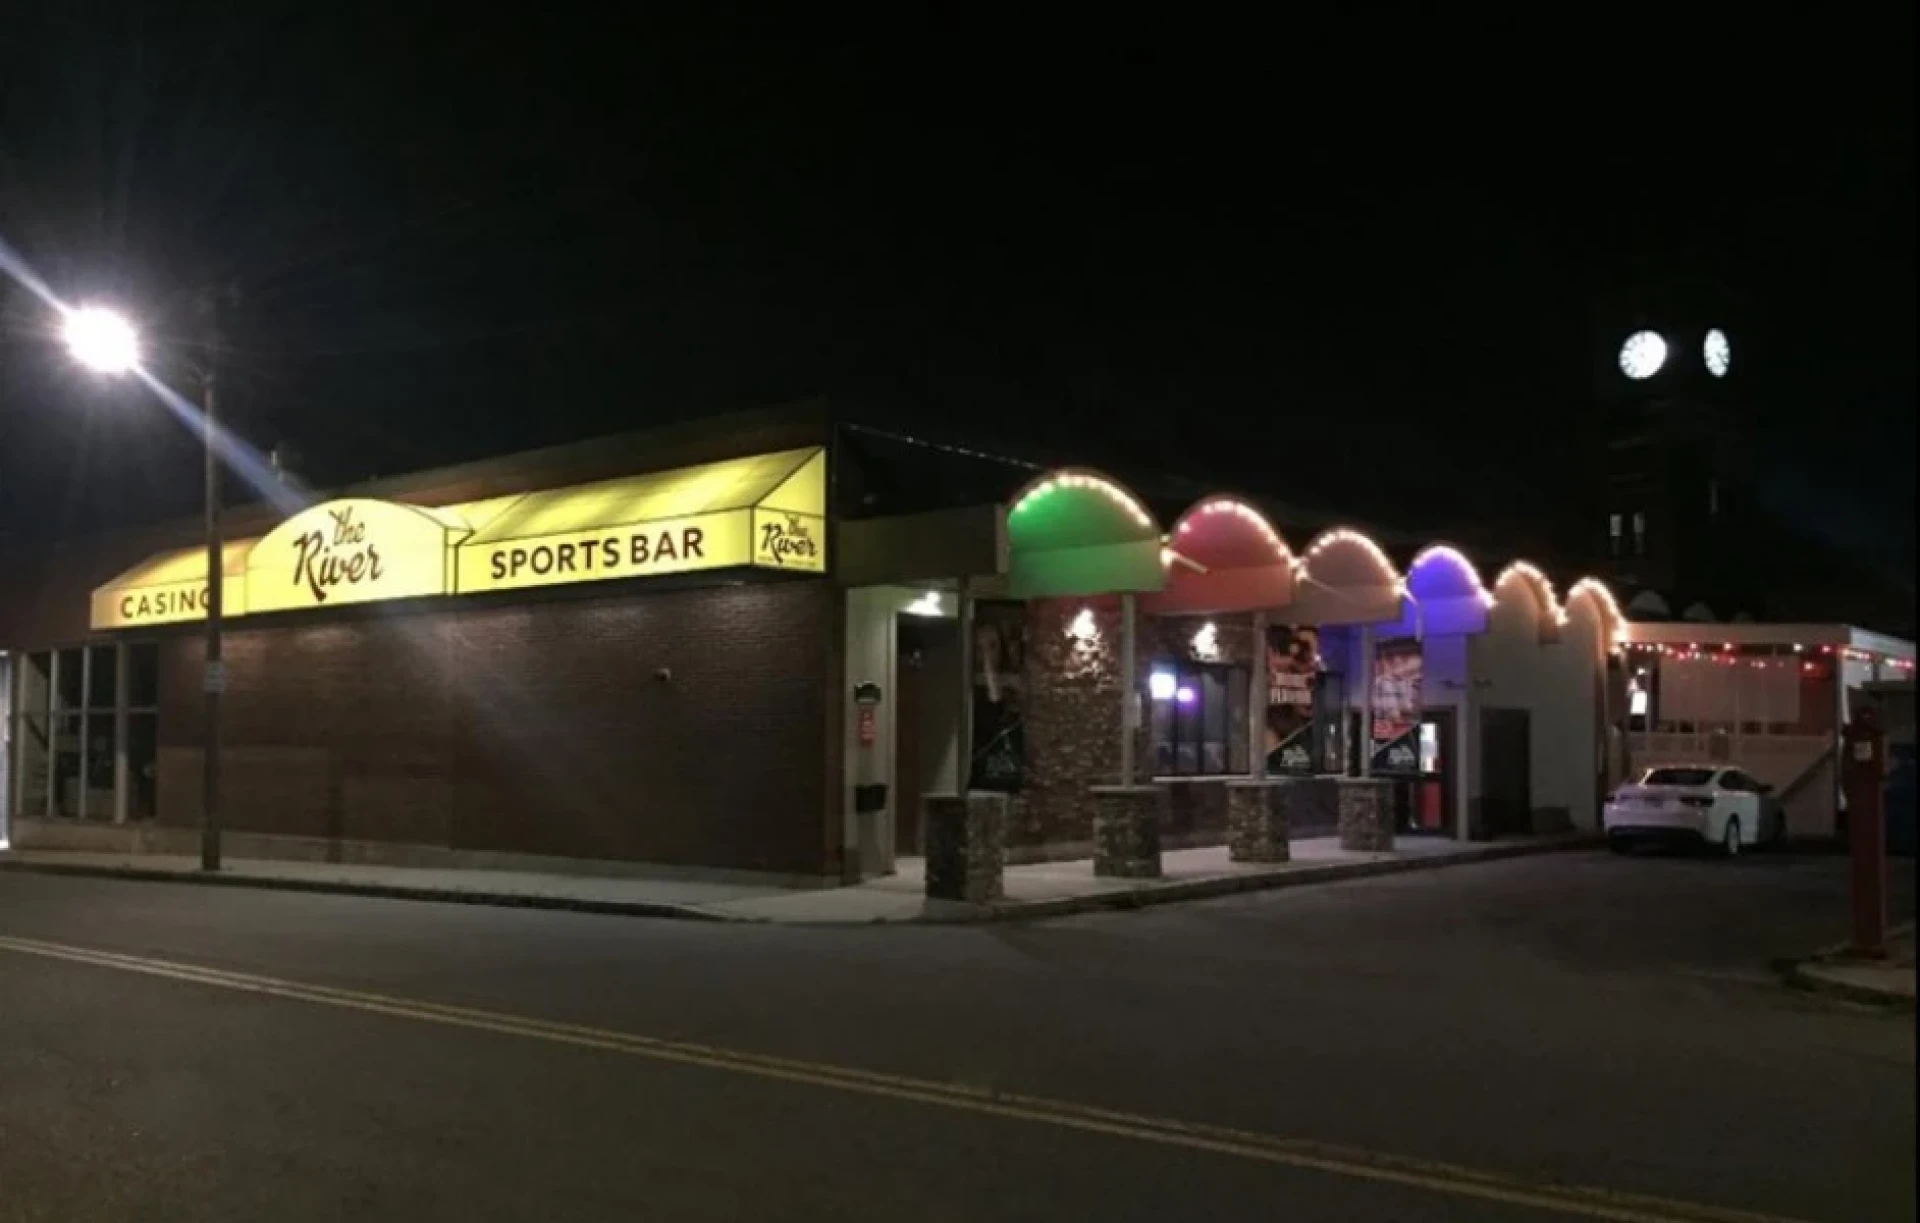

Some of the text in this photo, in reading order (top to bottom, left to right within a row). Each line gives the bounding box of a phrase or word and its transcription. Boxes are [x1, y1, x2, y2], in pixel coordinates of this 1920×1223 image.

[293, 530, 384, 602] River
[492, 527, 704, 580] SPORTS BAR
[760, 522, 818, 564] River
